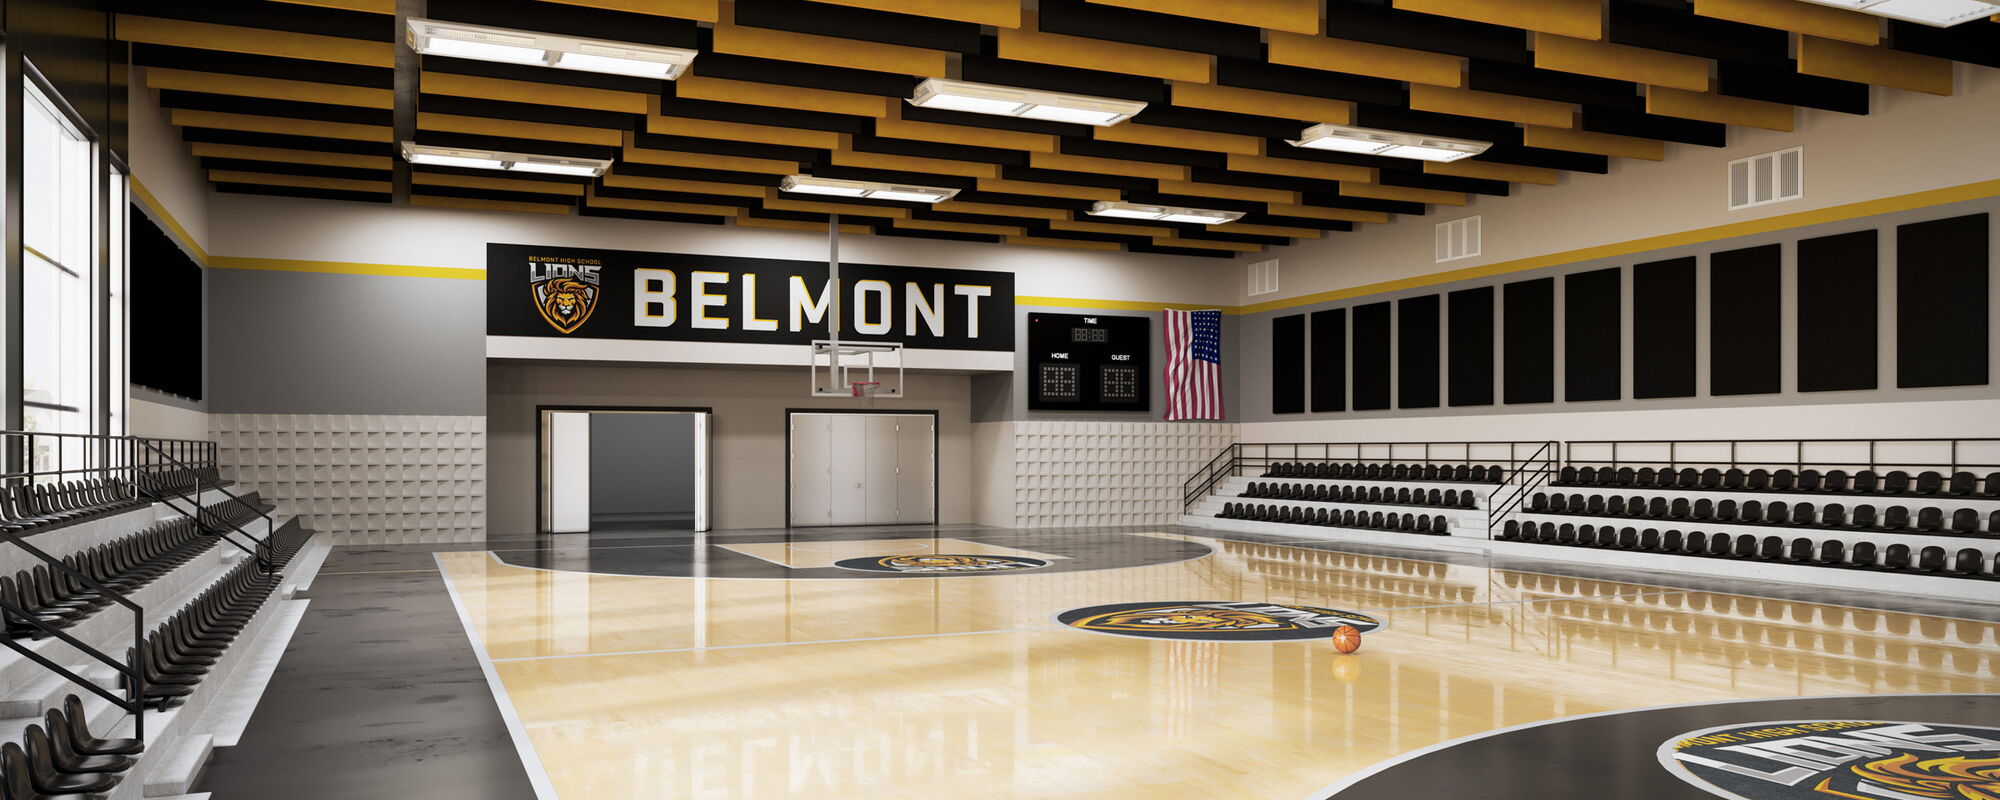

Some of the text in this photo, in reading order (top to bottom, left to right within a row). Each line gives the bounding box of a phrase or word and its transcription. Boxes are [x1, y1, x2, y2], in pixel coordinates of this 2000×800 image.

[528, 262, 602, 285] LIONS
[633, 268, 992, 338] BELMONT
[1736, 726, 1810, 738] HIGH
[1672, 723, 2000, 786] LIONS
